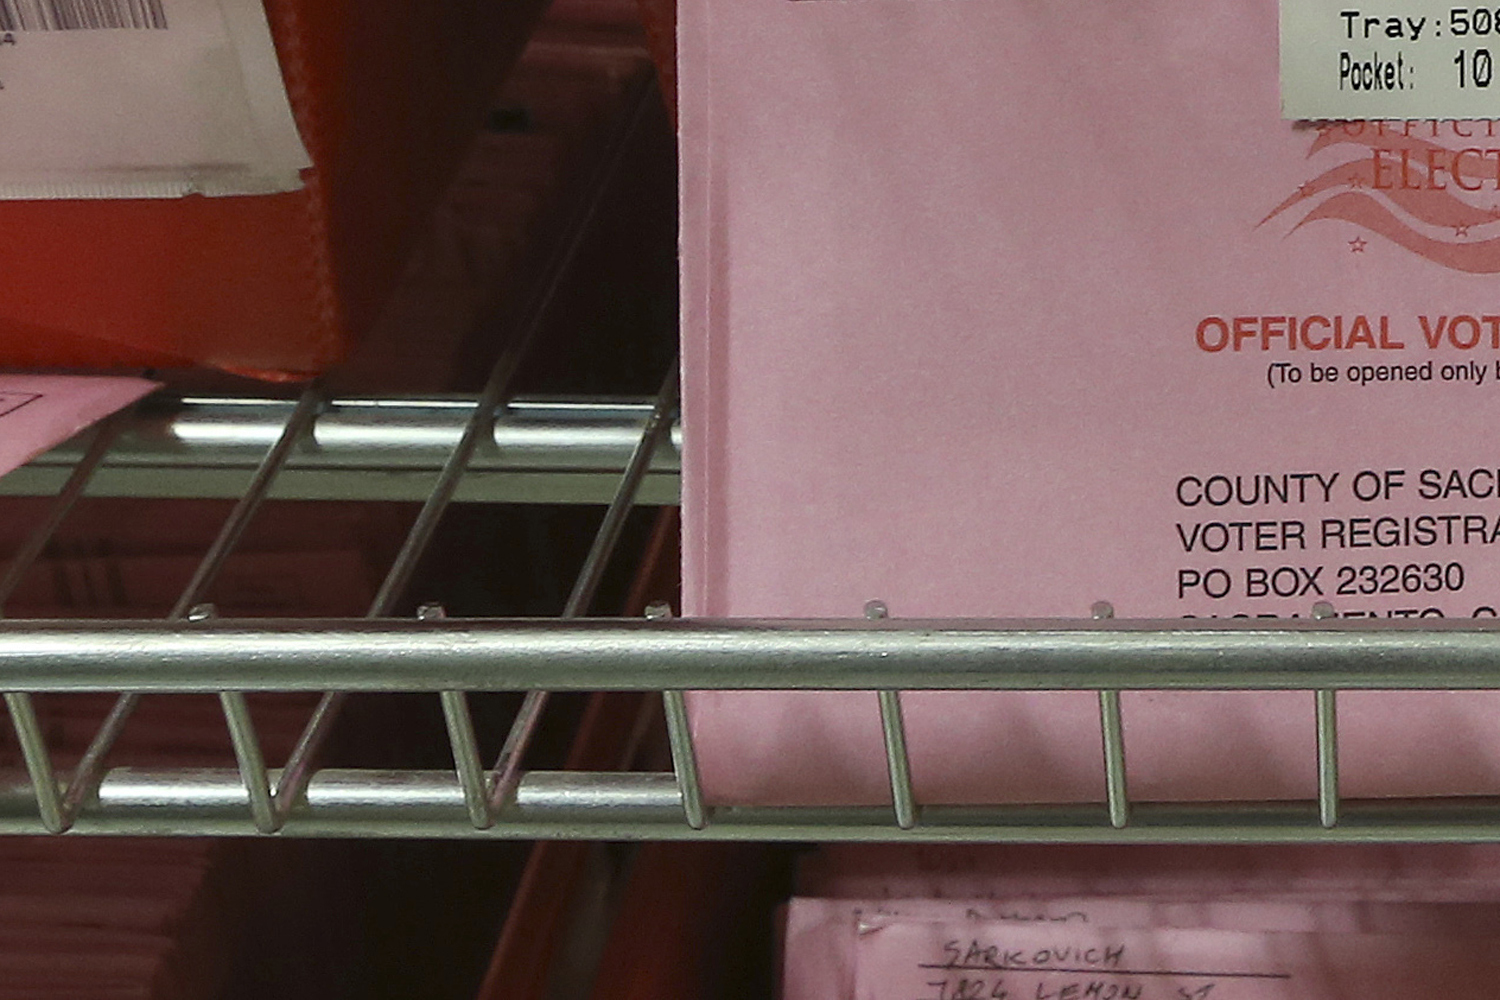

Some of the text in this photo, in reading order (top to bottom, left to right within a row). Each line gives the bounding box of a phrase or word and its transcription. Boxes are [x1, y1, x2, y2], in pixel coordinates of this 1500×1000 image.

[1340, 48, 1492, 91] Pocket: 10
[1195, 315, 1405, 352] OFFICIAL
[1267, 362, 1302, 388] (To
[1311, 362, 1338, 383] be
[1347, 361, 1433, 387] opened
[1441, 361, 1487, 387] only
[1176, 472, 1340, 507] COUNTY
[1352, 470, 1406, 502] OF
[1176, 521, 1306, 552] VOTER
[1178, 561, 1465, 599] PO BOX 232630
[944, 939, 1126, 968] SARKOVICH
